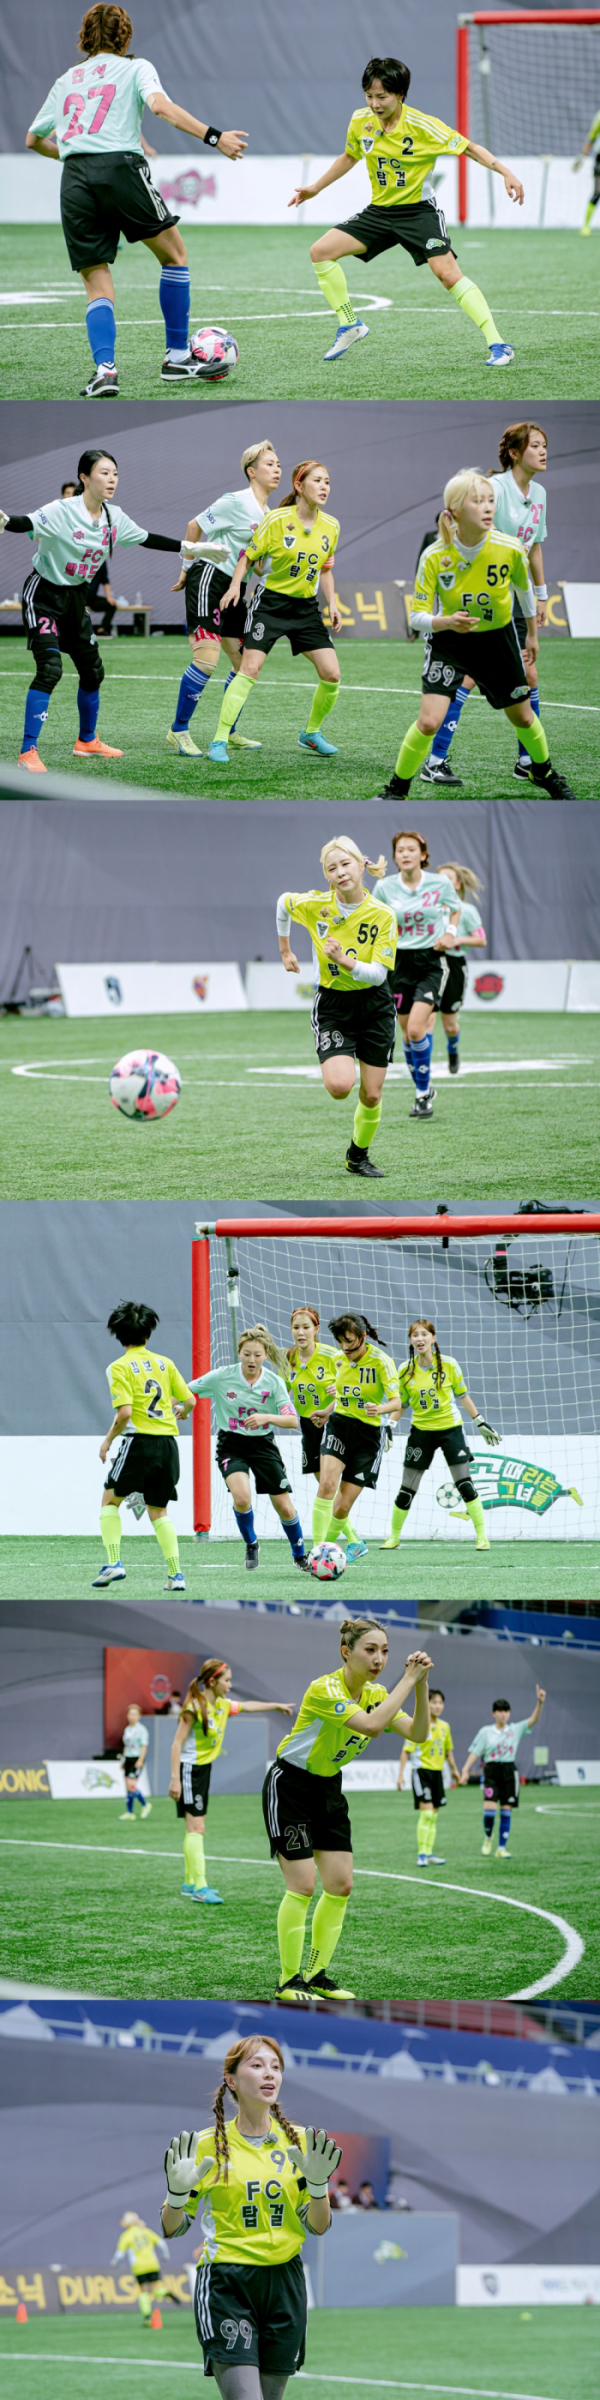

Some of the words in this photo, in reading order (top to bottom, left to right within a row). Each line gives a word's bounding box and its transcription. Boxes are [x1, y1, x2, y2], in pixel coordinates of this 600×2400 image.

[62, 84, 116, 143] 27
[402, 136, 414, 155] 2
[377, 157, 402, 169] FC
[531, 504, 543, 524] 27
[517, 526, 533, 543] FC
[321, 535, 330, 552] 3
[81, 548, 104, 563] FC
[297, 551, 319, 565] FC
[289, 565, 317, 582] 탑걸
[486, 564, 509, 587] 59
[461, 593, 490, 607] FC
[213, 608, 221, 626] 3
[38, 617, 58, 636] 24
[252, 622, 265, 641] 3
[427, 661, 455, 687] 59
[422, 890, 441, 907] 27
[404, 911, 424, 923] FC
[357, 923, 379, 945] 59
[319, 1030, 345, 1051] 59
[316, 1366, 325, 1380] 3
[359, 1367, 376, 1384] 111
[298, 1383, 316, 1393] FC
[343, 1385, 361, 1397] FC
[420, 1388, 437, 1399] FC
[144, 1379, 164, 1418] 2
[261, 1391, 270, 1404] 7
[238, 1406, 258, 1418] FC
[407, 1446, 422, 1462] 99
[345, 1735, 369, 1750] FC
[0, 1768, 49, 1793] ONIC
[284, 1824, 309, 1850] 21
[246, 2179, 282, 2201] FC
[241, 2203, 284, 2228] 탑걸
[58, 2275, 192, 2306] DUALSNIC
[220, 2319, 252, 2349] 99
